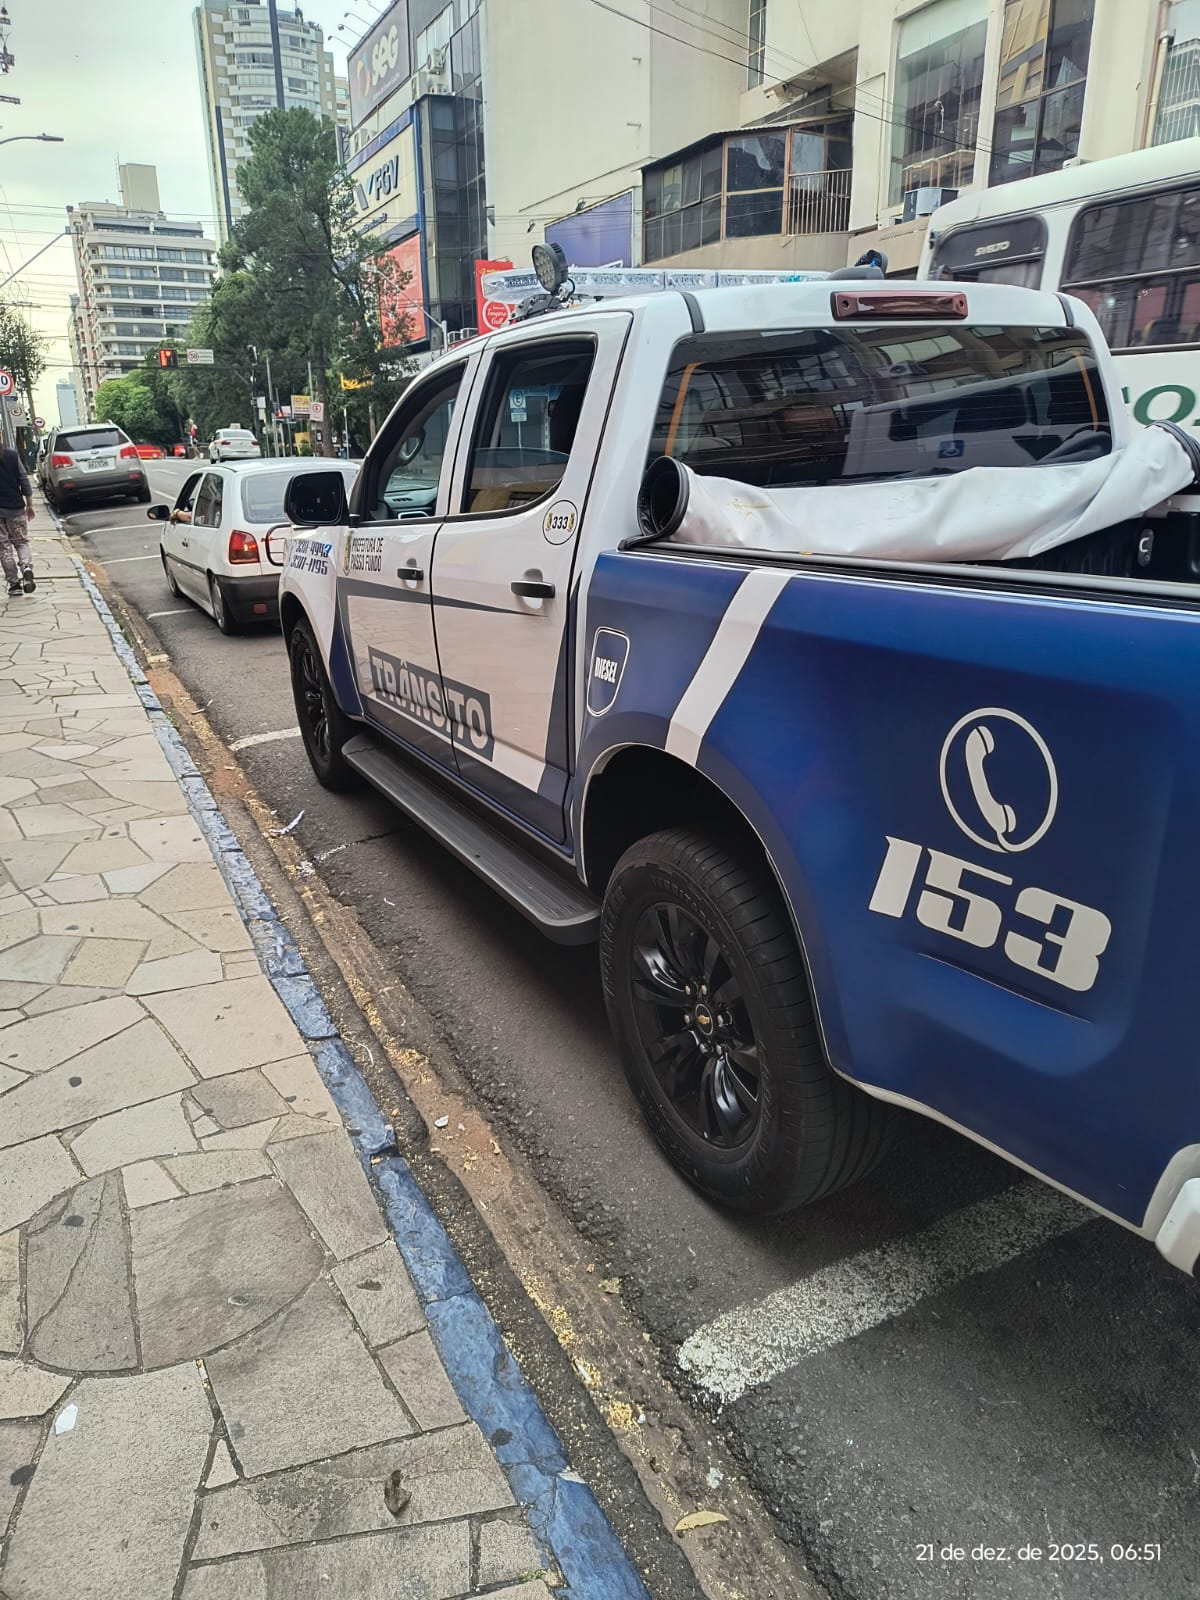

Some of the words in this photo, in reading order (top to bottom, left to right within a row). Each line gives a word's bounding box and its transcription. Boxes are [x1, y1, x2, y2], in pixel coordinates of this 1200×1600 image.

[374, 154, 399, 201] FGV
[0, 375, 8, 385] 0
[552, 516, 569, 530] 333
[352, 537, 376, 553] PREFEITURA
[376, 537, 384, 553] DE
[351, 553, 365, 571] PASSO
[365, 554, 382, 572] FUNDO
[594, 656, 618, 684] DIESEL
[371, 655, 488, 750] TRÂNSITO
[868, 835, 1112, 992] 153
